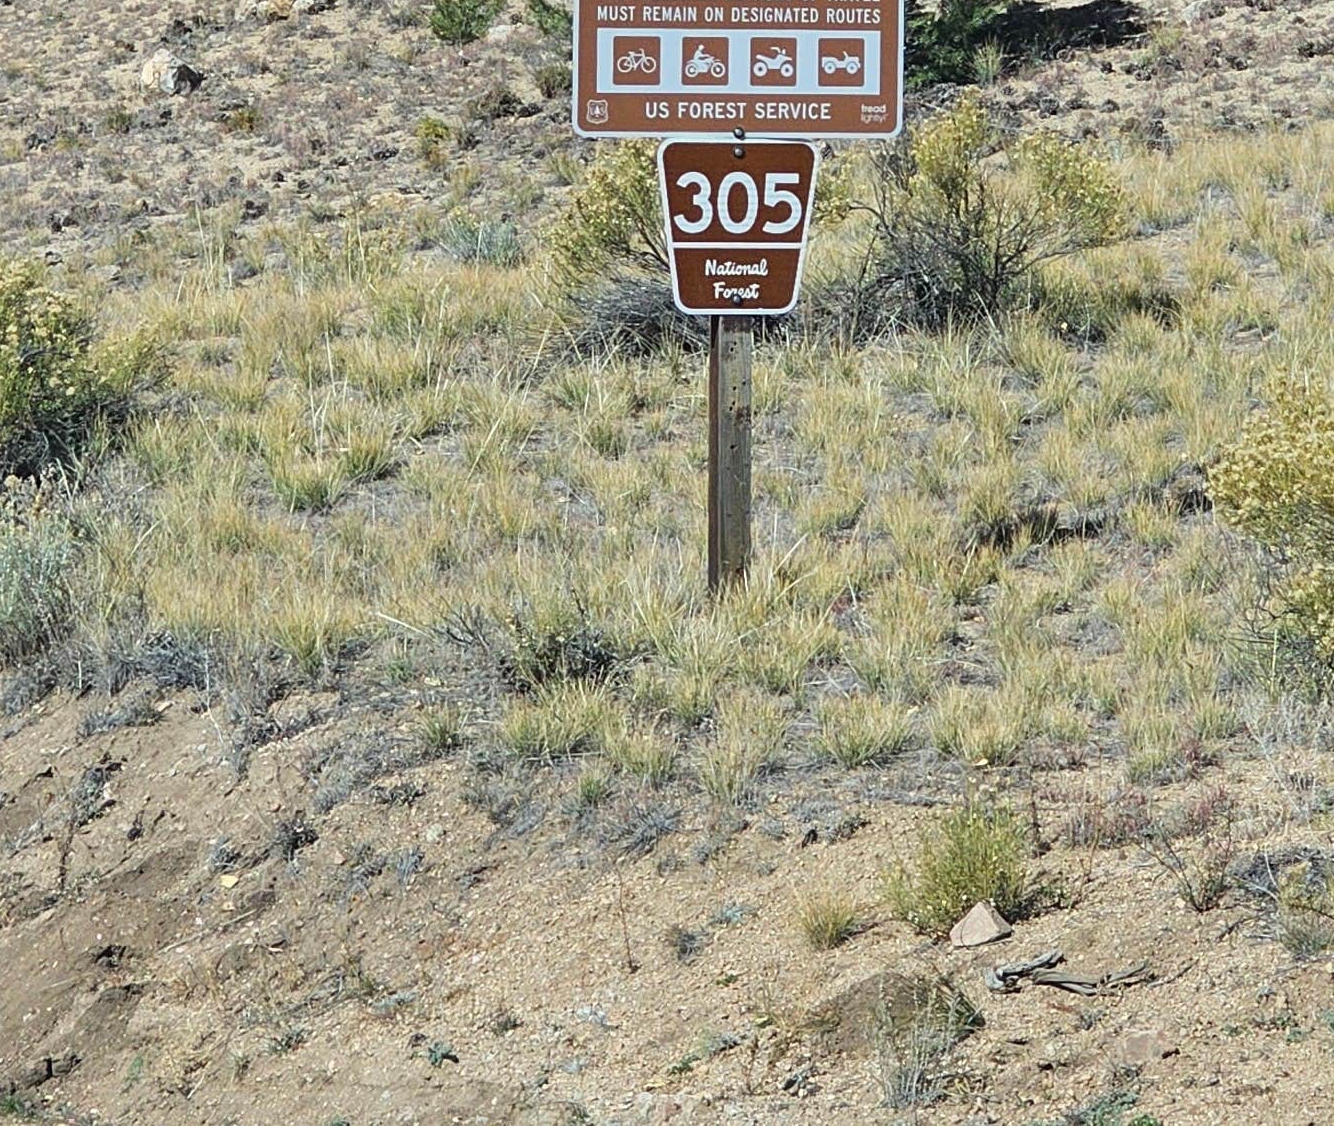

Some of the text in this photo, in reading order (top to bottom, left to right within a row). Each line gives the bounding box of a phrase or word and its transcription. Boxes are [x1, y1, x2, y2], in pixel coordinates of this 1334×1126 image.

[597, 6, 880, 23] MUST REMAIN ON DESIGNATED ROUTES
[645, 103, 831, 120] US FOREST SERVICE
[861, 104, 886, 113] tread
[673, 172, 802, 233] 305
[705, 259, 768, 276] National
[713, 282, 760, 299] Forest
